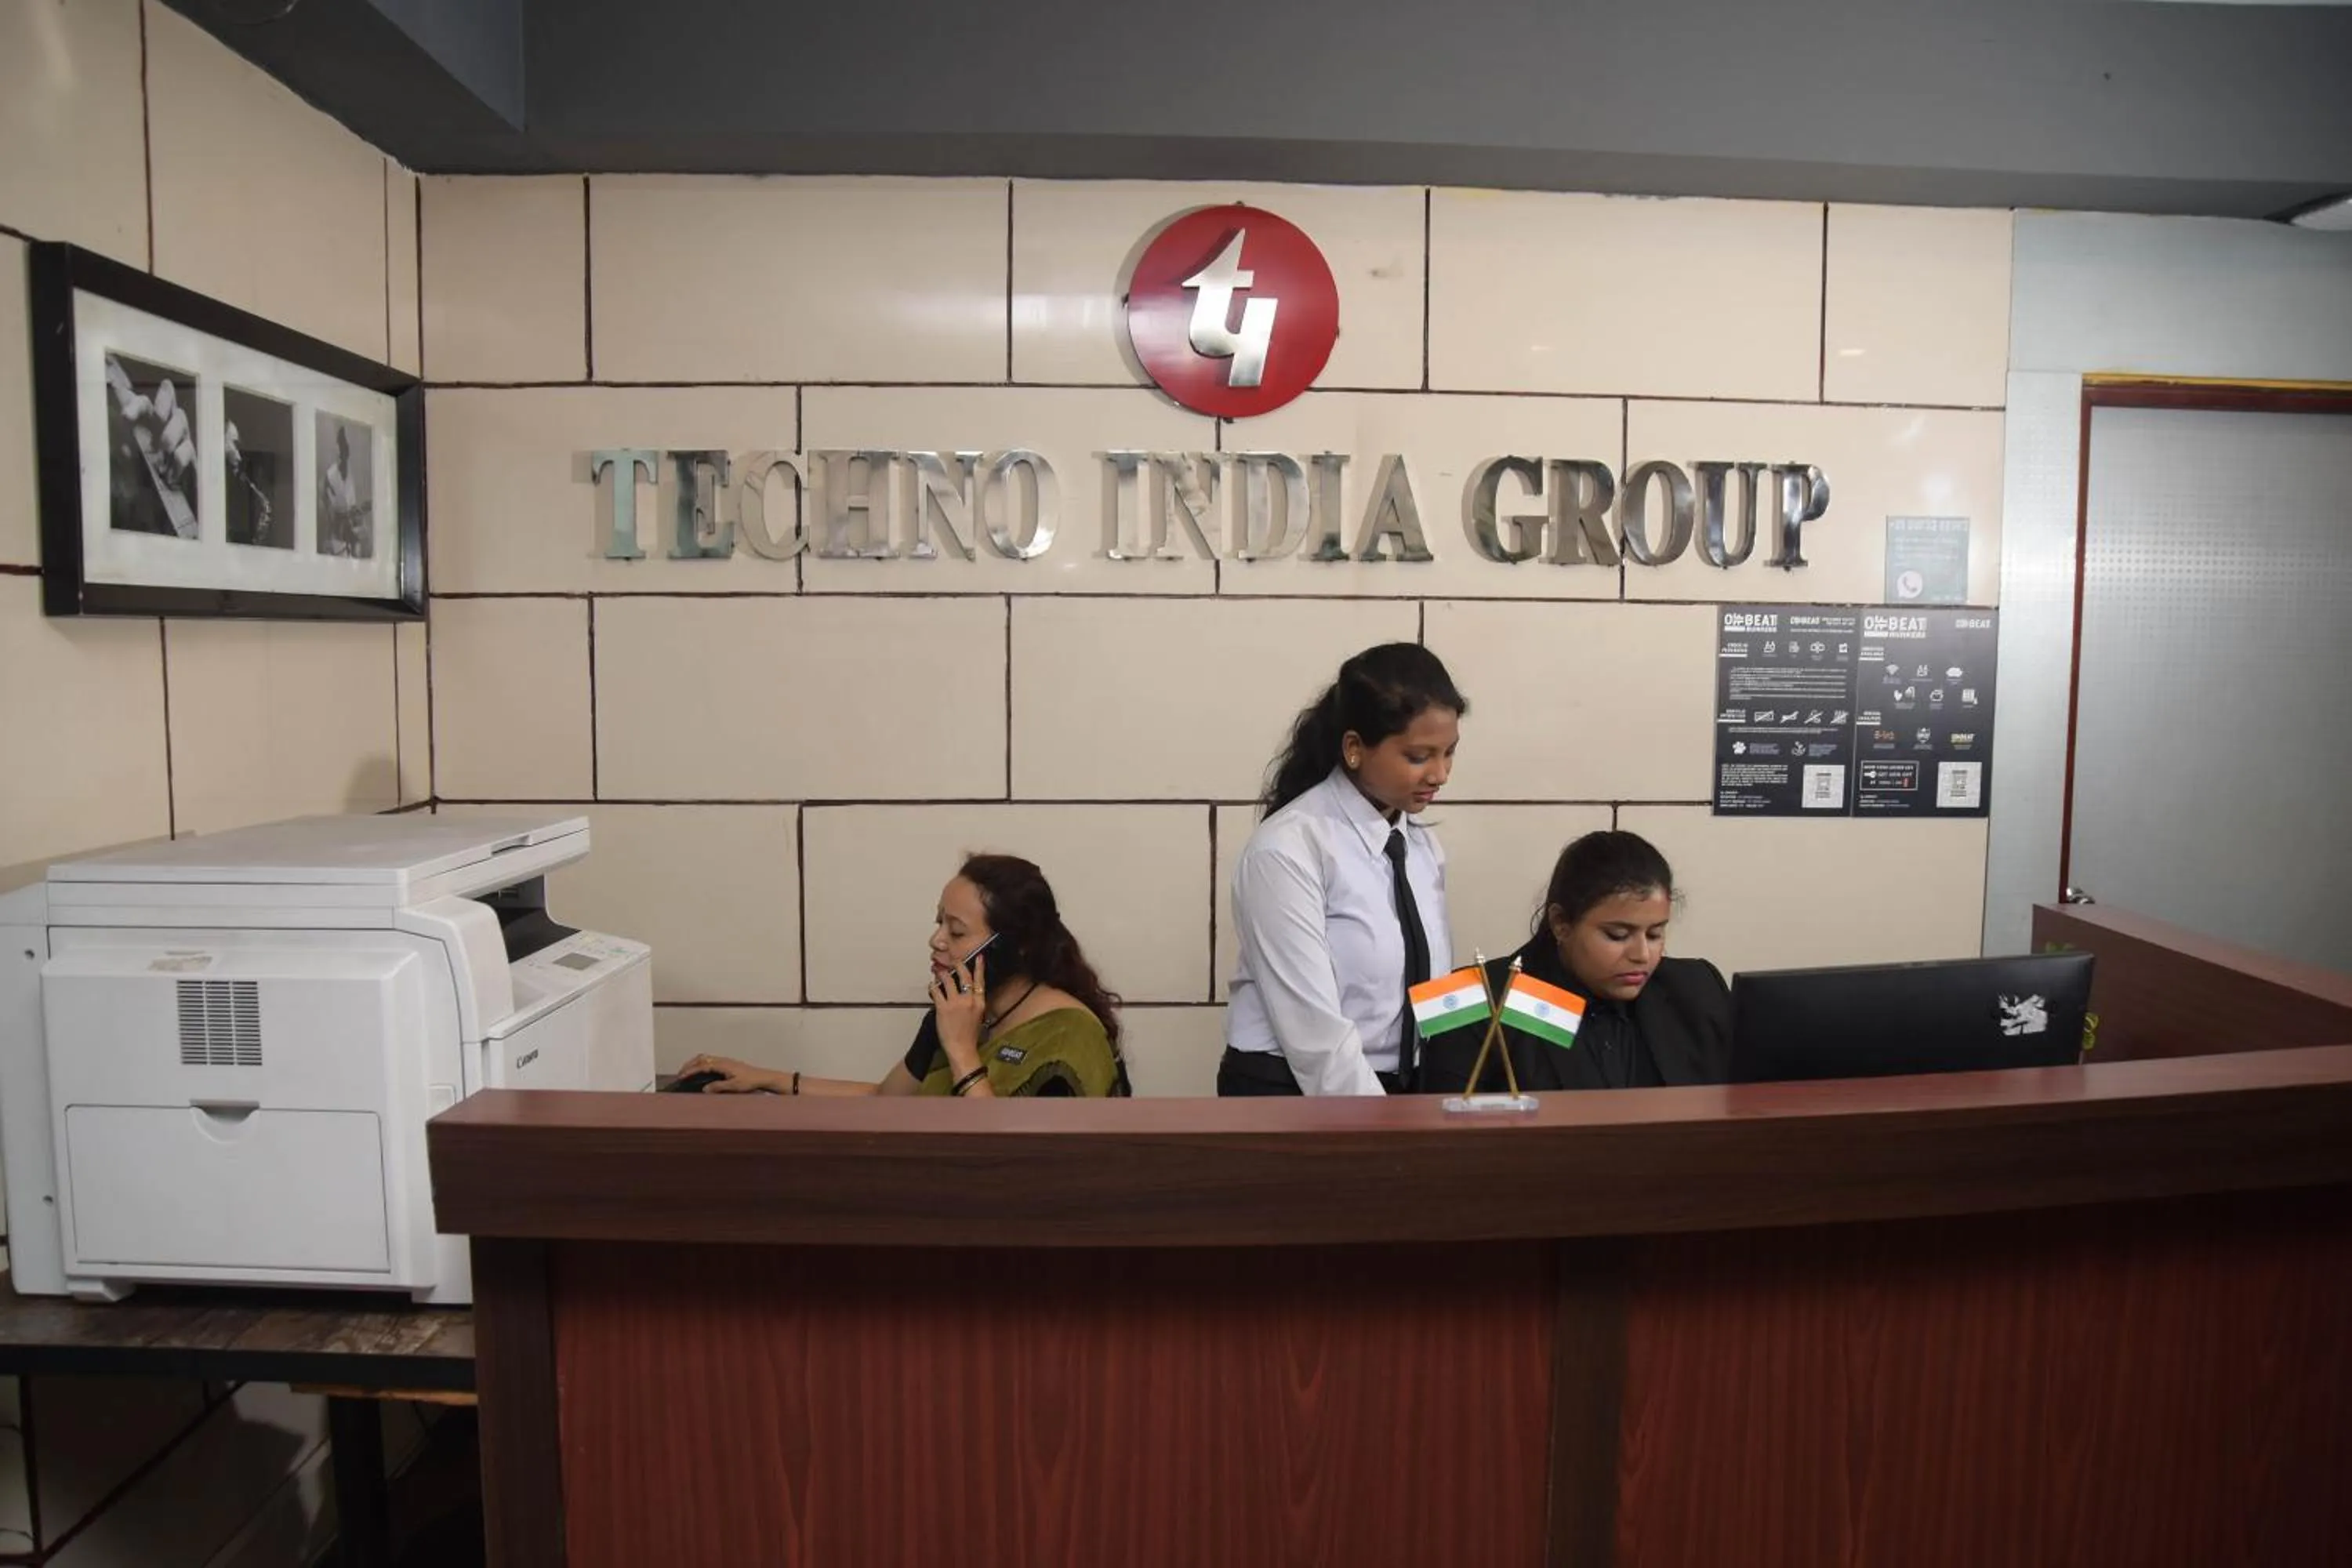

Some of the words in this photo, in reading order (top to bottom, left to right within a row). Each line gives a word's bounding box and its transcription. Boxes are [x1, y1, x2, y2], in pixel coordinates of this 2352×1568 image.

[591, 449, 1058, 562] TECHNO
[1100, 450, 1434, 562] INDIA
[1468, 455, 1831, 568] GROUP
